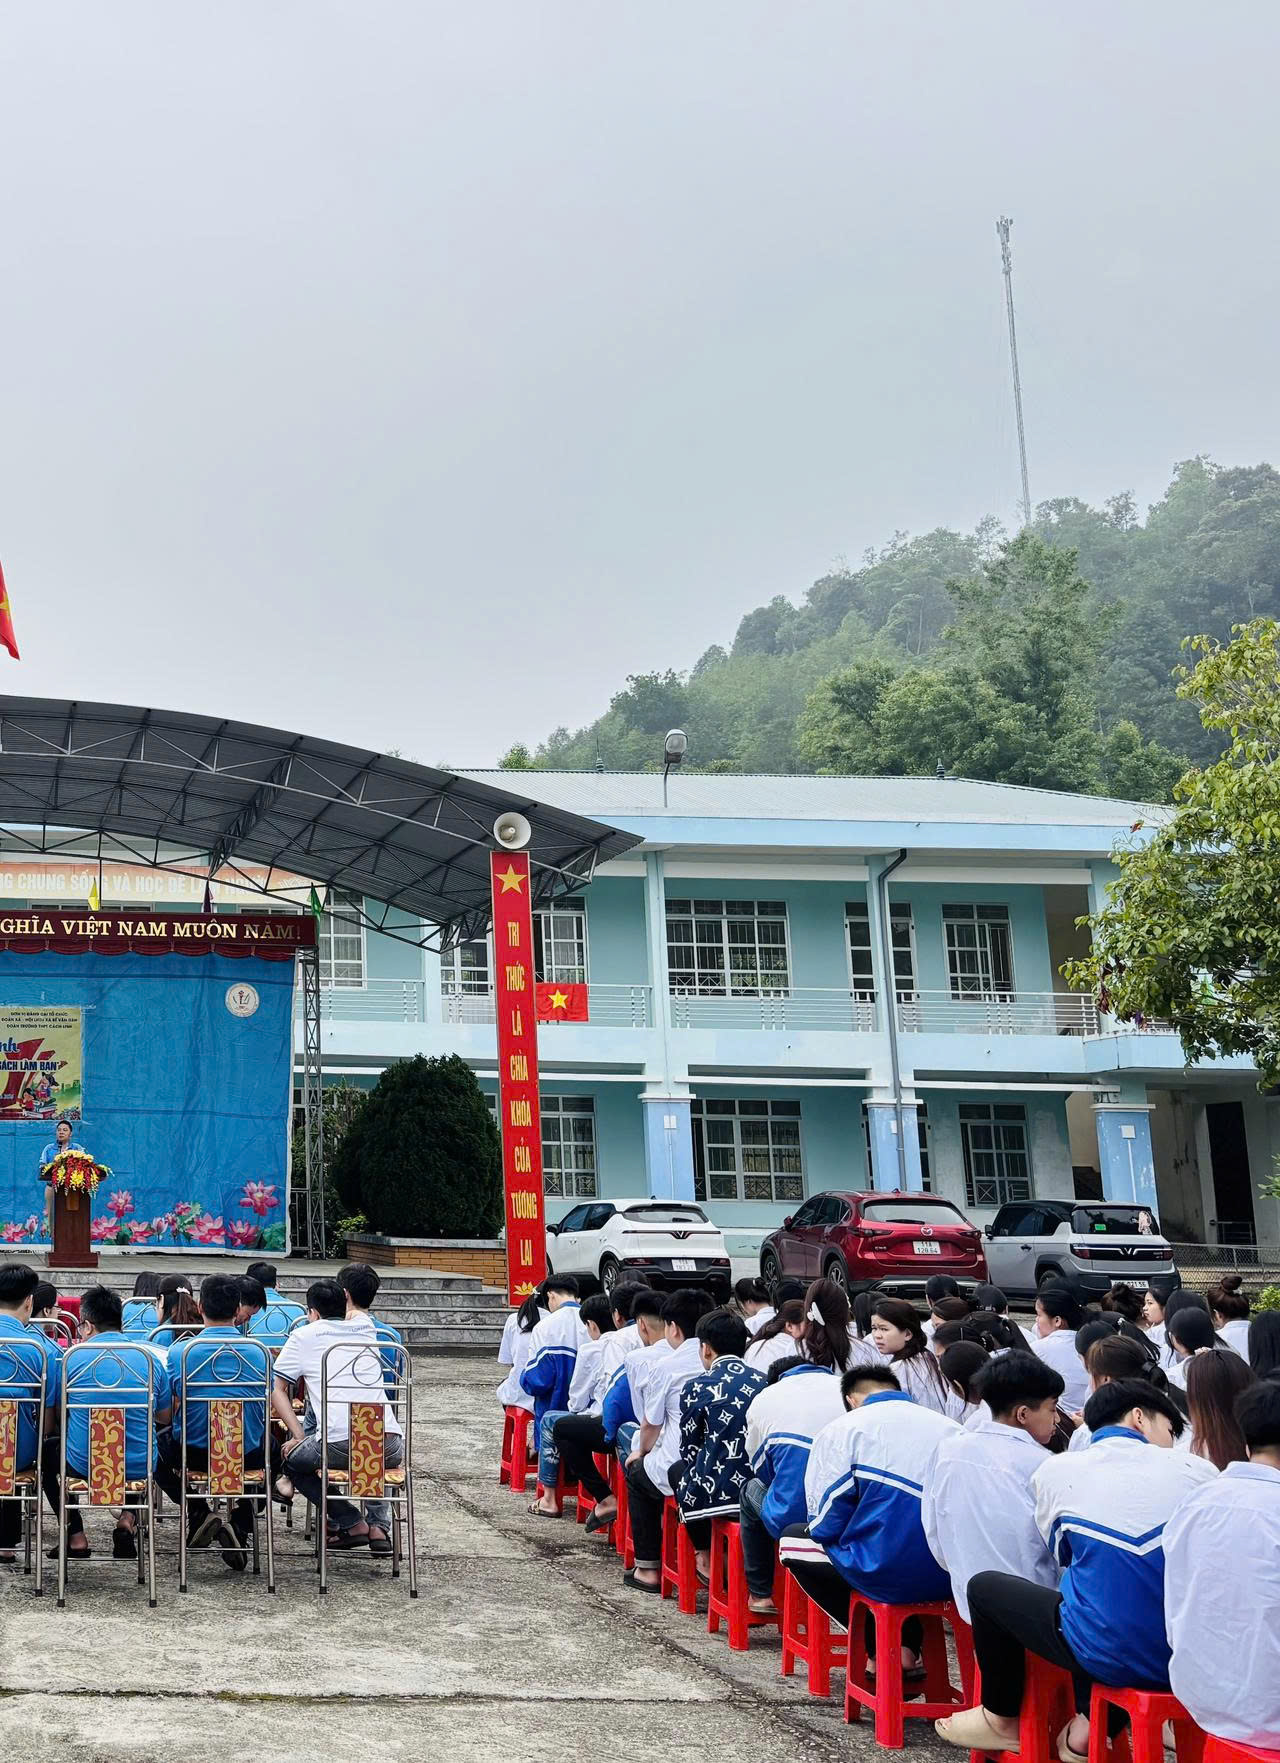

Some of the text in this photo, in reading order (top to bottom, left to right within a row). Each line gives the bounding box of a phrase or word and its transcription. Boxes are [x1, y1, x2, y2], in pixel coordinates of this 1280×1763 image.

[18, 873, 65, 891] CHUNG
[112, 872, 131, 892] VÀ
[136, 874, 164, 896] HỌC
[61, 916, 112, 939] VIỆT
[117, 921, 167, 937] NAM
[172, 918, 238, 938] MUÔN
[243, 921, 301, 940] NĂM!
[20, 1058, 37, 1070] LÀM
[506, 921, 538, 1266] TRI THỨC LÀ CHÌA KHÓA CỦA TƯƠNG LAI
